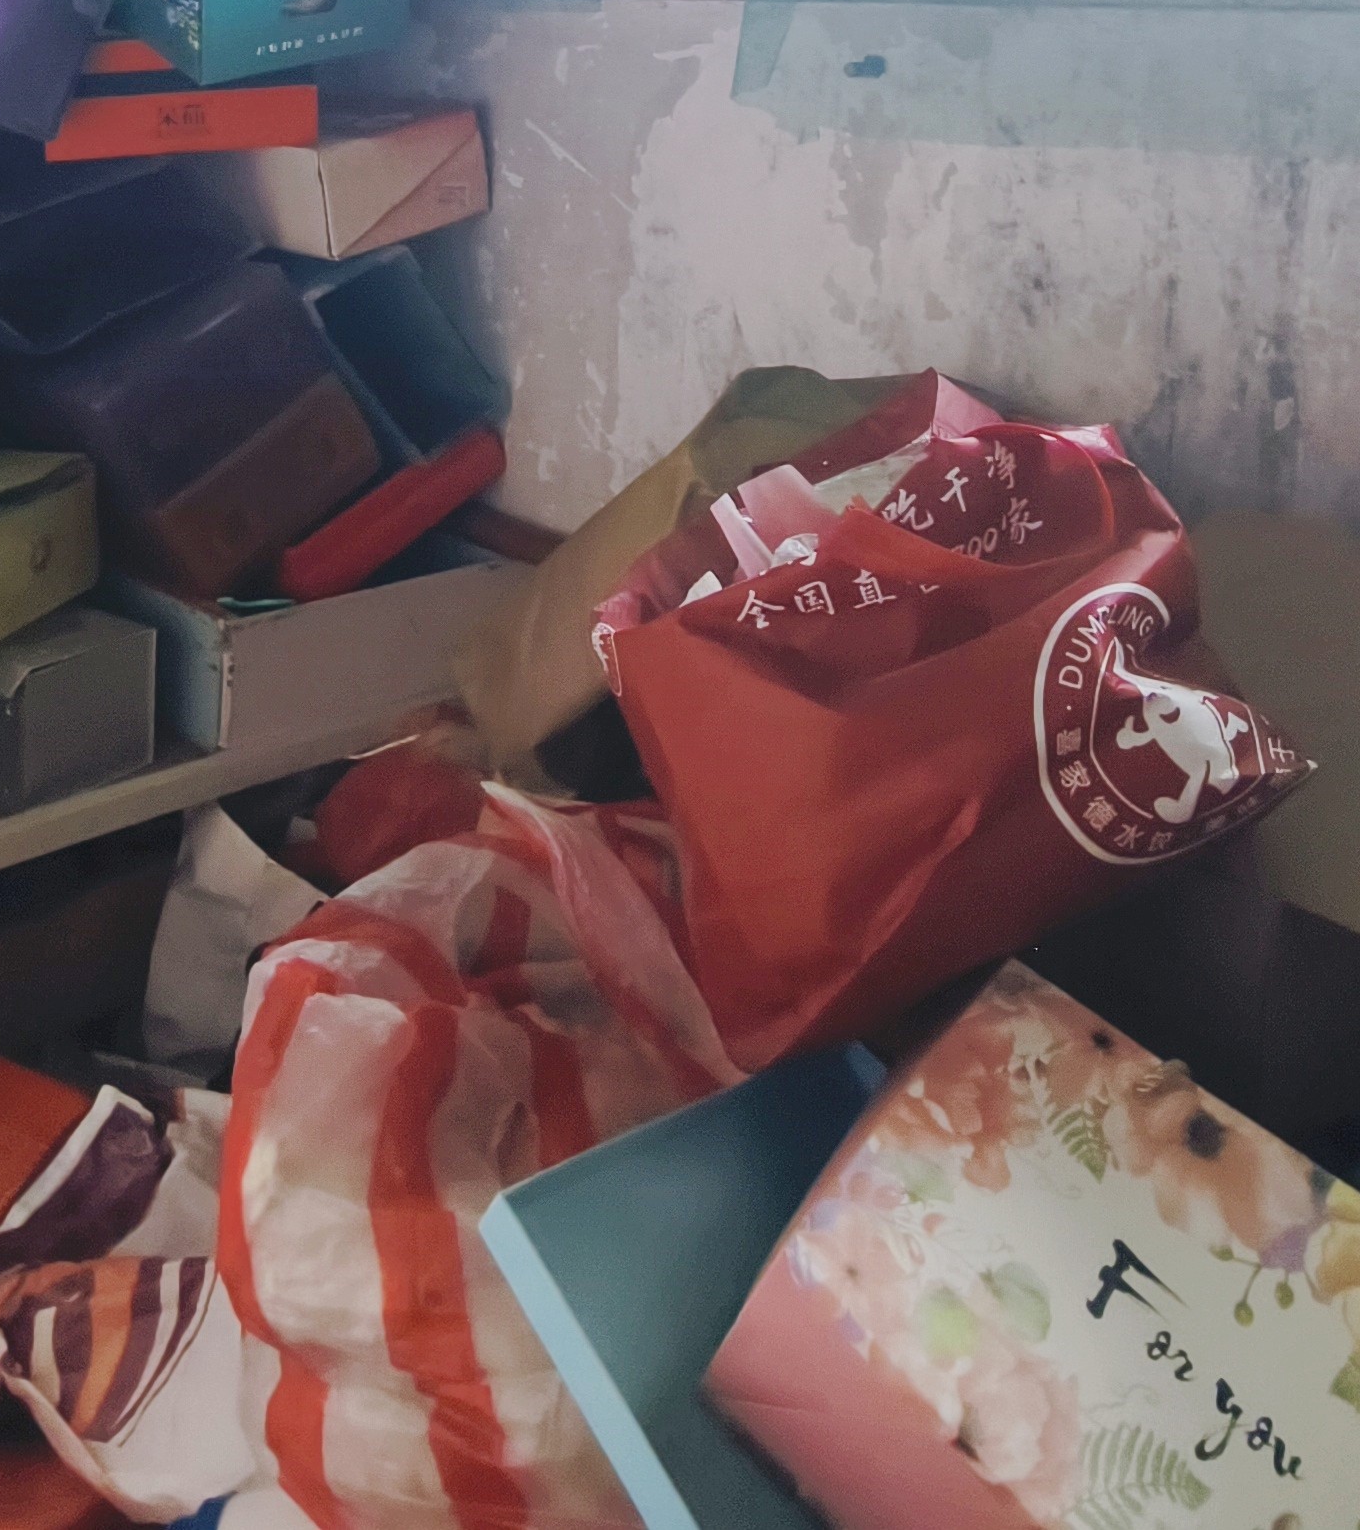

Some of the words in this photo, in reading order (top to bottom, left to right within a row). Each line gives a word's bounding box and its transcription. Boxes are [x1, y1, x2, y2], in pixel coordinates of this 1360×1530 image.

[737, 569, 940, 630] 全国直
[1086, 1238, 1192, 1382] For
[1194, 1378, 1305, 1481] you
